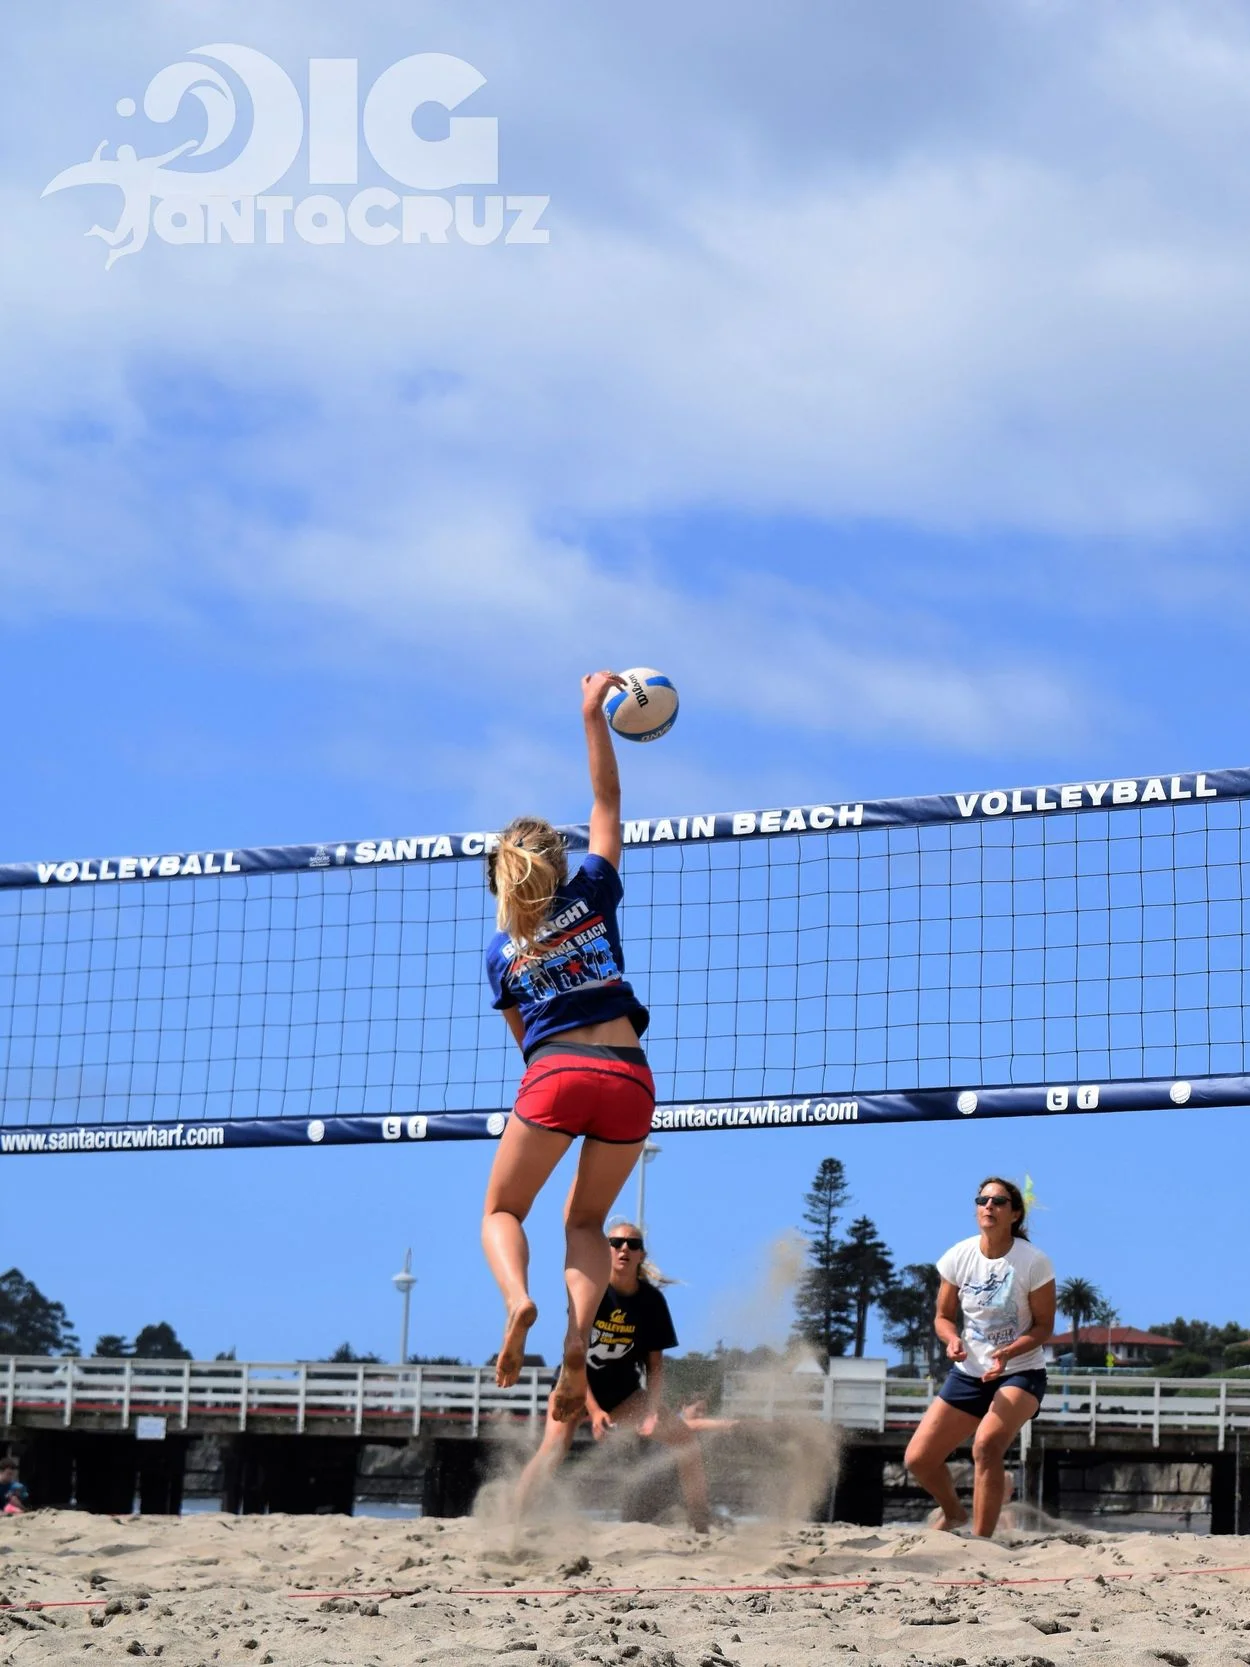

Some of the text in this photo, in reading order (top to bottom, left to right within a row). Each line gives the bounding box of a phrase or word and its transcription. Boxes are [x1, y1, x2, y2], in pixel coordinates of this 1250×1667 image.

[628, 673, 649, 708] Wilson
[955, 774, 1217, 817] VOLLEYBALL
[353, 835, 451, 864] SANTA
[623, 815, 716, 844] MAIN
[732, 803, 864, 835] BEACH
[37, 851, 241, 883] VOLLEYBALL
[574, 922, 608, 946] BEACH
[1, 1124, 225, 1153] www.santacruzwharf.com
